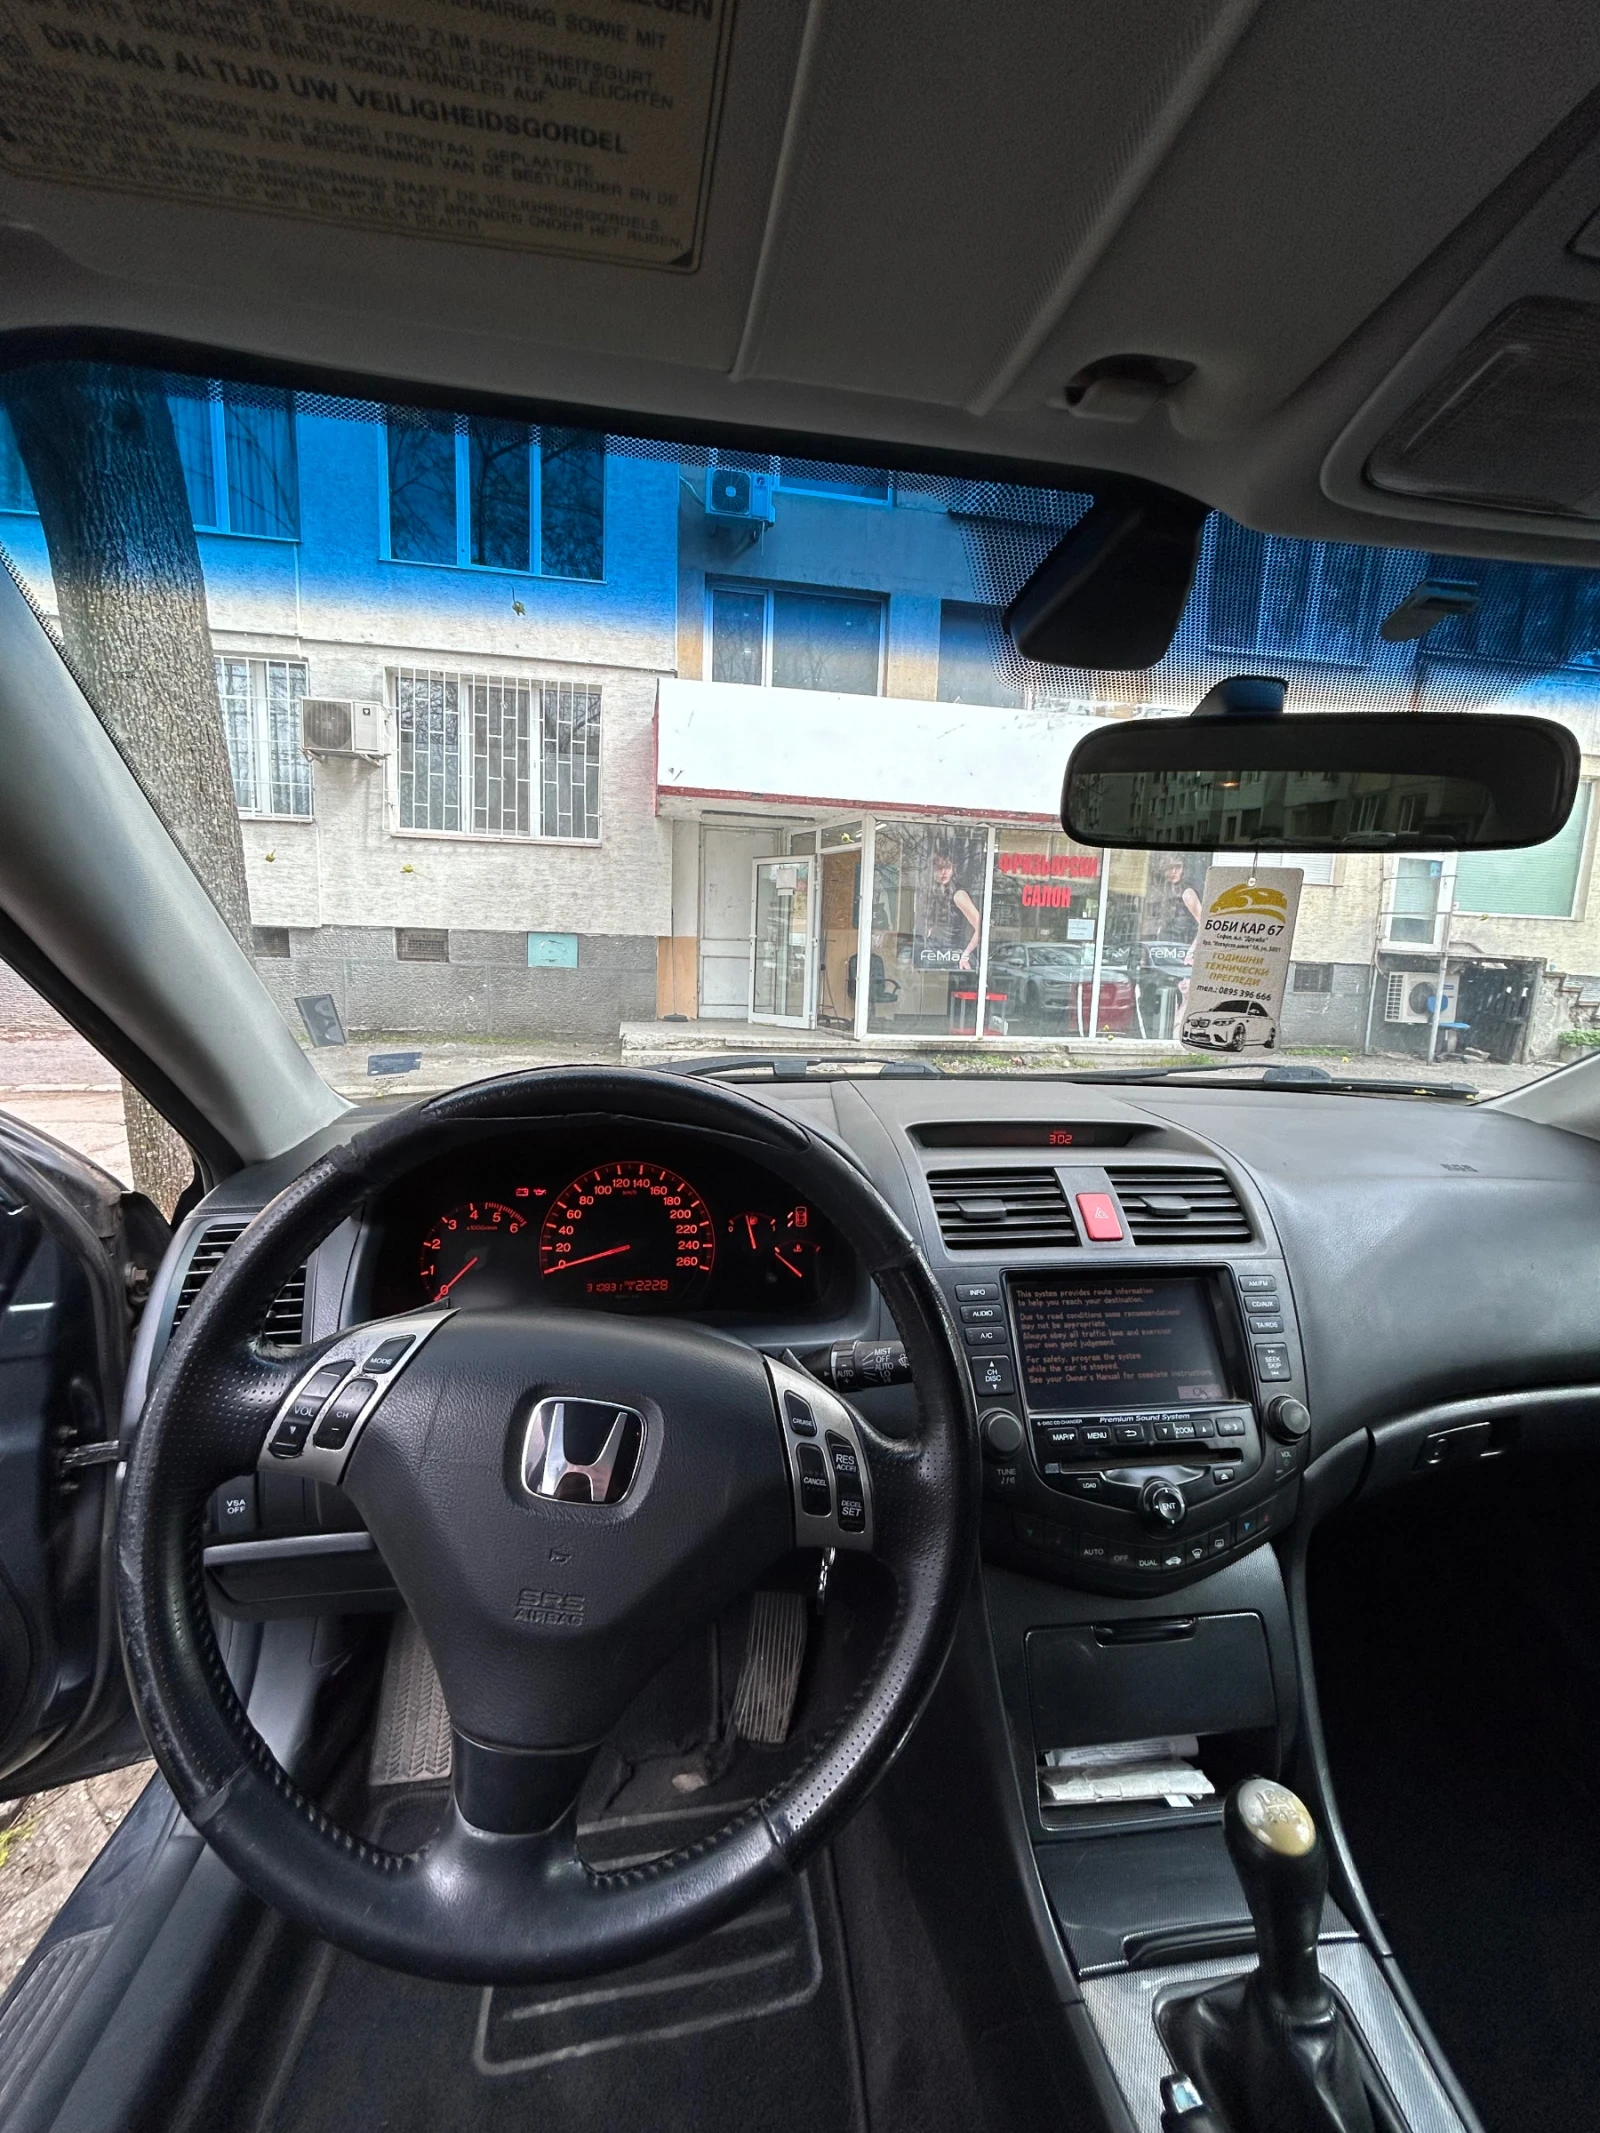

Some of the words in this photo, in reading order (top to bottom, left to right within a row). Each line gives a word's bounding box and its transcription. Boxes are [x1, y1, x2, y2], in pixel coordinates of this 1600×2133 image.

[566, 13, 628, 42] SOWIE
[636, 28, 667, 51] MIT
[480, 38, 655, 86] SICHERHEITSGURT
[39, 23, 166, 71] DRAAG
[175, 51, 279, 93] ALTIJD
[286, 73, 337, 104] UW
[347, 84, 629, 154] VEILIGHEIDSGORDEL
[541, 68, 674, 111] AUFLEUCHTEN
[998, 852, 1099, 878] ФРИЗЬОРСКИ
[1022, 884, 1072, 908] САЛОН
[1204, 919, 1239, 933] БОБИ
[1240, 920, 1266, 934] КАР
[1267, 924, 1285, 936] 67
[1212, 952, 1264, 965] ГОДИШНИ
[1205, 962, 1270, 976] ТЕХНИЧЕСКИ
[1209, 973, 1261, 986] ПРЕГЛЕДИ
[1218, 985, 1238, 996] 0895
[1239, 987, 1254, 998] 396
[1255, 989, 1272, 1001] 666
[612, 1178, 630, 1188] 120
[633, 1178, 650, 1188] 140
[594, 1185, 612, 1195] 100
[650, 1186, 668, 1195] 160
[579, 1196, 594, 1205] 80
[663, 1196, 681, 1206] 180
[470, 1210, 478, 1220] 4
[492, 1212, 501, 1222] 5
[566, 1209, 582, 1219] 60
[669, 1209, 691, 1219] 200
[448, 1219, 457, 1230] 3
[510, 1223, 518, 1233] 6
[676, 1225, 697, 1234] 220
[727, 1225, 734, 1233] 0
[558, 1225, 574, 1235] 40
[431, 1239, 441, 1249] 2
[556, 1243, 571, 1252] 20
[678, 1241, 700, 1250] 240
[558, 1260, 566, 1269] 0
[676, 1257, 698, 1266] 260
[430, 1265, 435, 1275] 1
[1016, 1290, 1032, 1298] This
[1035, 1290, 1058, 1299] system
[1060, 1288, 1090, 1298] provides
[1093, 1288, 1112, 1296] route
[1115, 1287, 1154, 1295] information
[1028, 1299, 1045, 1308] help
[1047, 1300, 1059, 1308] you
[1061, 1297, 1082, 1305] reach
[1085, 1298, 1101, 1306] your
[1020, 1313, 1034, 1321] Due
[1037, 1312, 1044, 1320] to
[1047, 1312, 1064, 1320] road
[1066, 1311, 1101, 1319] conditions
[1037, 1321, 1049, 1329] not
[1023, 1331, 1047, 1340] Always
[1050, 1331, 1067, 1340] obey
[1069, 1330, 1080, 1338] all
[1082, 1329, 1106, 1337] traffic
[1024, 1342, 1040, 1350] your
[1060, 1340, 1077, 1349] good
[874, 1347, 892, 1356] MIST
[370, 1357, 393, 1365] MODE
[875, 1355, 890, 1363] OFF
[1071, 1354, 1101, 1363] program
[1118, 1353, 1142, 1361] system
[875, 1362, 894, 1371] AUTO
[1050, 1364, 1061, 1372] the
[837, 1369, 854, 1378] AUTO
[880, 1370, 891, 1378] LO
[1047, 1375, 1062, 1383] your
[1066, 1373, 1094, 1382] Owner's
[1096, 1372, 1120, 1380] Manual
[1192, 1387, 1208, 1397] OK
[294, 1405, 315, 1418] VOL
[336, 1411, 350, 1419] CH
[792, 1417, 813, 1426] CRUISE
[1099, 1416, 1133, 1424] Premium
[1162, 1413, 1190, 1422] System
[1175, 1426, 1194, 1435] ZOOM
[1087, 1432, 1107, 1440] MENU
[835, 1453, 855, 1465] RES
[997, 1468, 1016, 1476] TUNE
[803, 1476, 827, 1487] CANCEL
[226, 1499, 246, 1507] VSA
[841, 1500, 863, 1508] DECEL
[1161, 1502, 1176, 1510] ENT
[227, 1506, 246, 1515] OFF
[841, 1507, 862, 1517] SET
[1084, 1548, 1104, 1556] AUTO
[518, 1588, 585, 1611] SRS
[514, 1609, 584, 1627] AIRBAG
